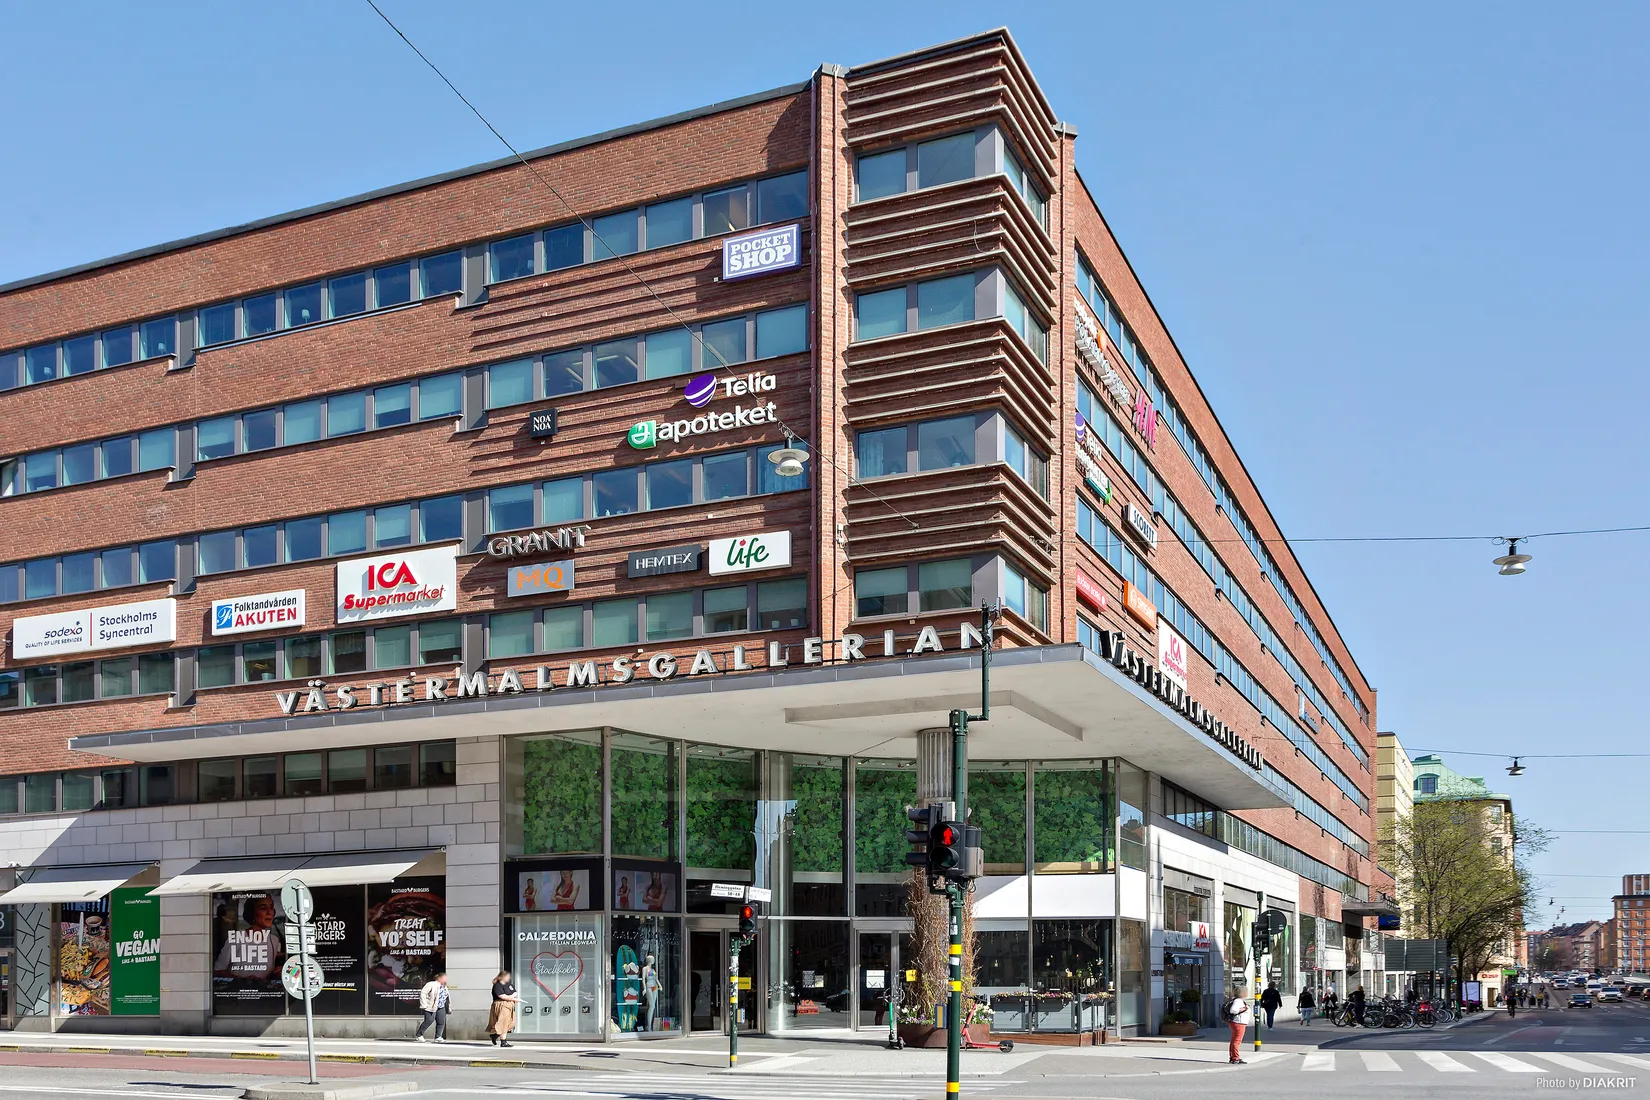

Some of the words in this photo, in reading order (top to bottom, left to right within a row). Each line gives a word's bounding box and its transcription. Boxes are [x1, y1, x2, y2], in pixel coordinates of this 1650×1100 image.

[731, 233, 790, 255] POCKET
[730, 244, 791, 272] SHOP
[720, 372, 776, 397] Telia
[533, 413, 552, 424] NOA
[533, 423, 552, 432] NOA
[658, 401, 777, 444] apoteket
[487, 525, 591, 557] GRANIT
[635, 552, 692, 570] HEMTEX
[368, 561, 418, 591] ICA
[517, 566, 565, 590] MQ
[234, 596, 297, 612] Folktandvården
[343, 584, 447, 611] Supermarket
[100, 611, 158, 627] Stockholms
[235, 607, 297, 627] AKUTEN
[44, 626, 83, 639] sodexo
[100, 623, 153, 641] Syncentral
[25, 640, 44, 648] QUALITY
[61, 636, 83, 644] SERVICES
[1170, 634, 1182, 663] ICA
[276, 620, 993, 715] VÄSTERMALMSGALLERIAN
[1101, 630, 1263, 770] VÄSTERMALMSGALLERIAN
[315, 921, 346, 931] STARD
[394, 918, 426, 930] TREAT
[133, 930, 144, 939] GO
[227, 929, 271, 944] ENJOY
[405, 930, 443, 947] SELF
[518, 931, 596, 941] CALZEDONIA
[115, 938, 160, 957] VEGAN
[231, 944, 268, 963] LIFE
[405, 948, 431, 956] BASTARD
[135, 955, 157, 963] BASTARD
[535, 963, 579, 975] Stockholm
